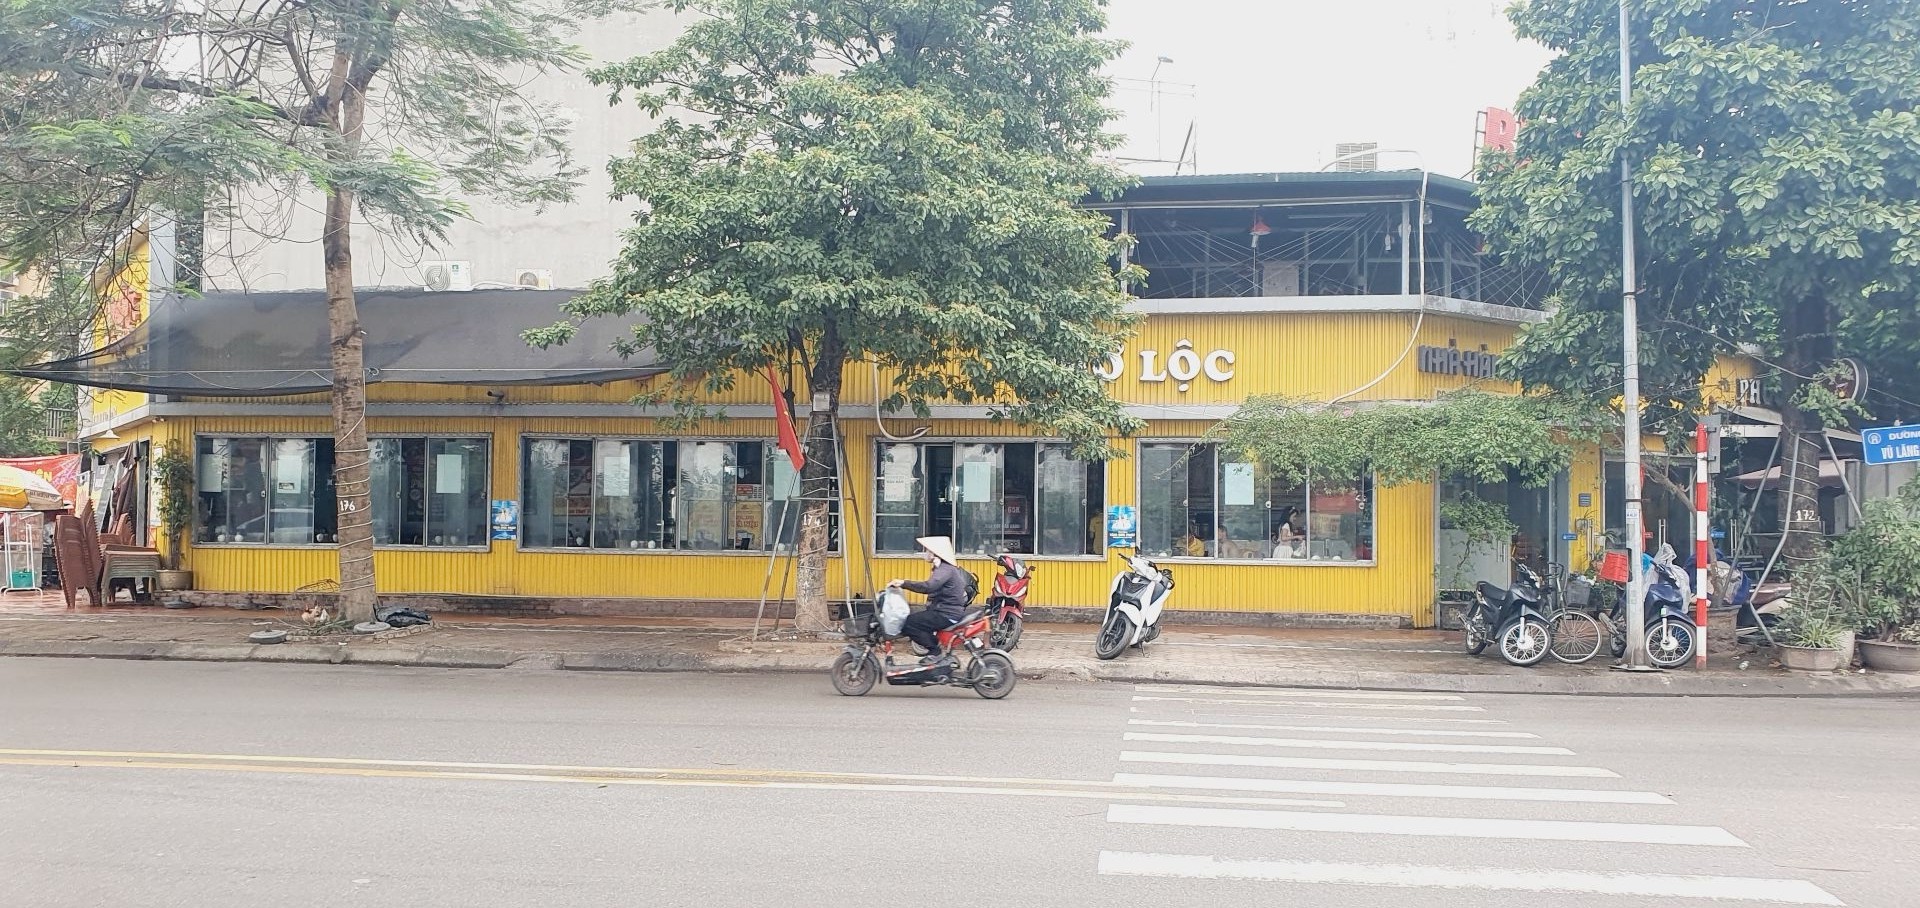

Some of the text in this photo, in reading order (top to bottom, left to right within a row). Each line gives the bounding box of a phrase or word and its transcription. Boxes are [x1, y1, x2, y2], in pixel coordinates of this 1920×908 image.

[1139, 338, 1236, 392] LỘC
[1738, 379, 1761, 404] PH
[339, 500, 356, 512] 176
[803, 513, 821, 526] 174
[1795, 509, 1816, 521] 172
